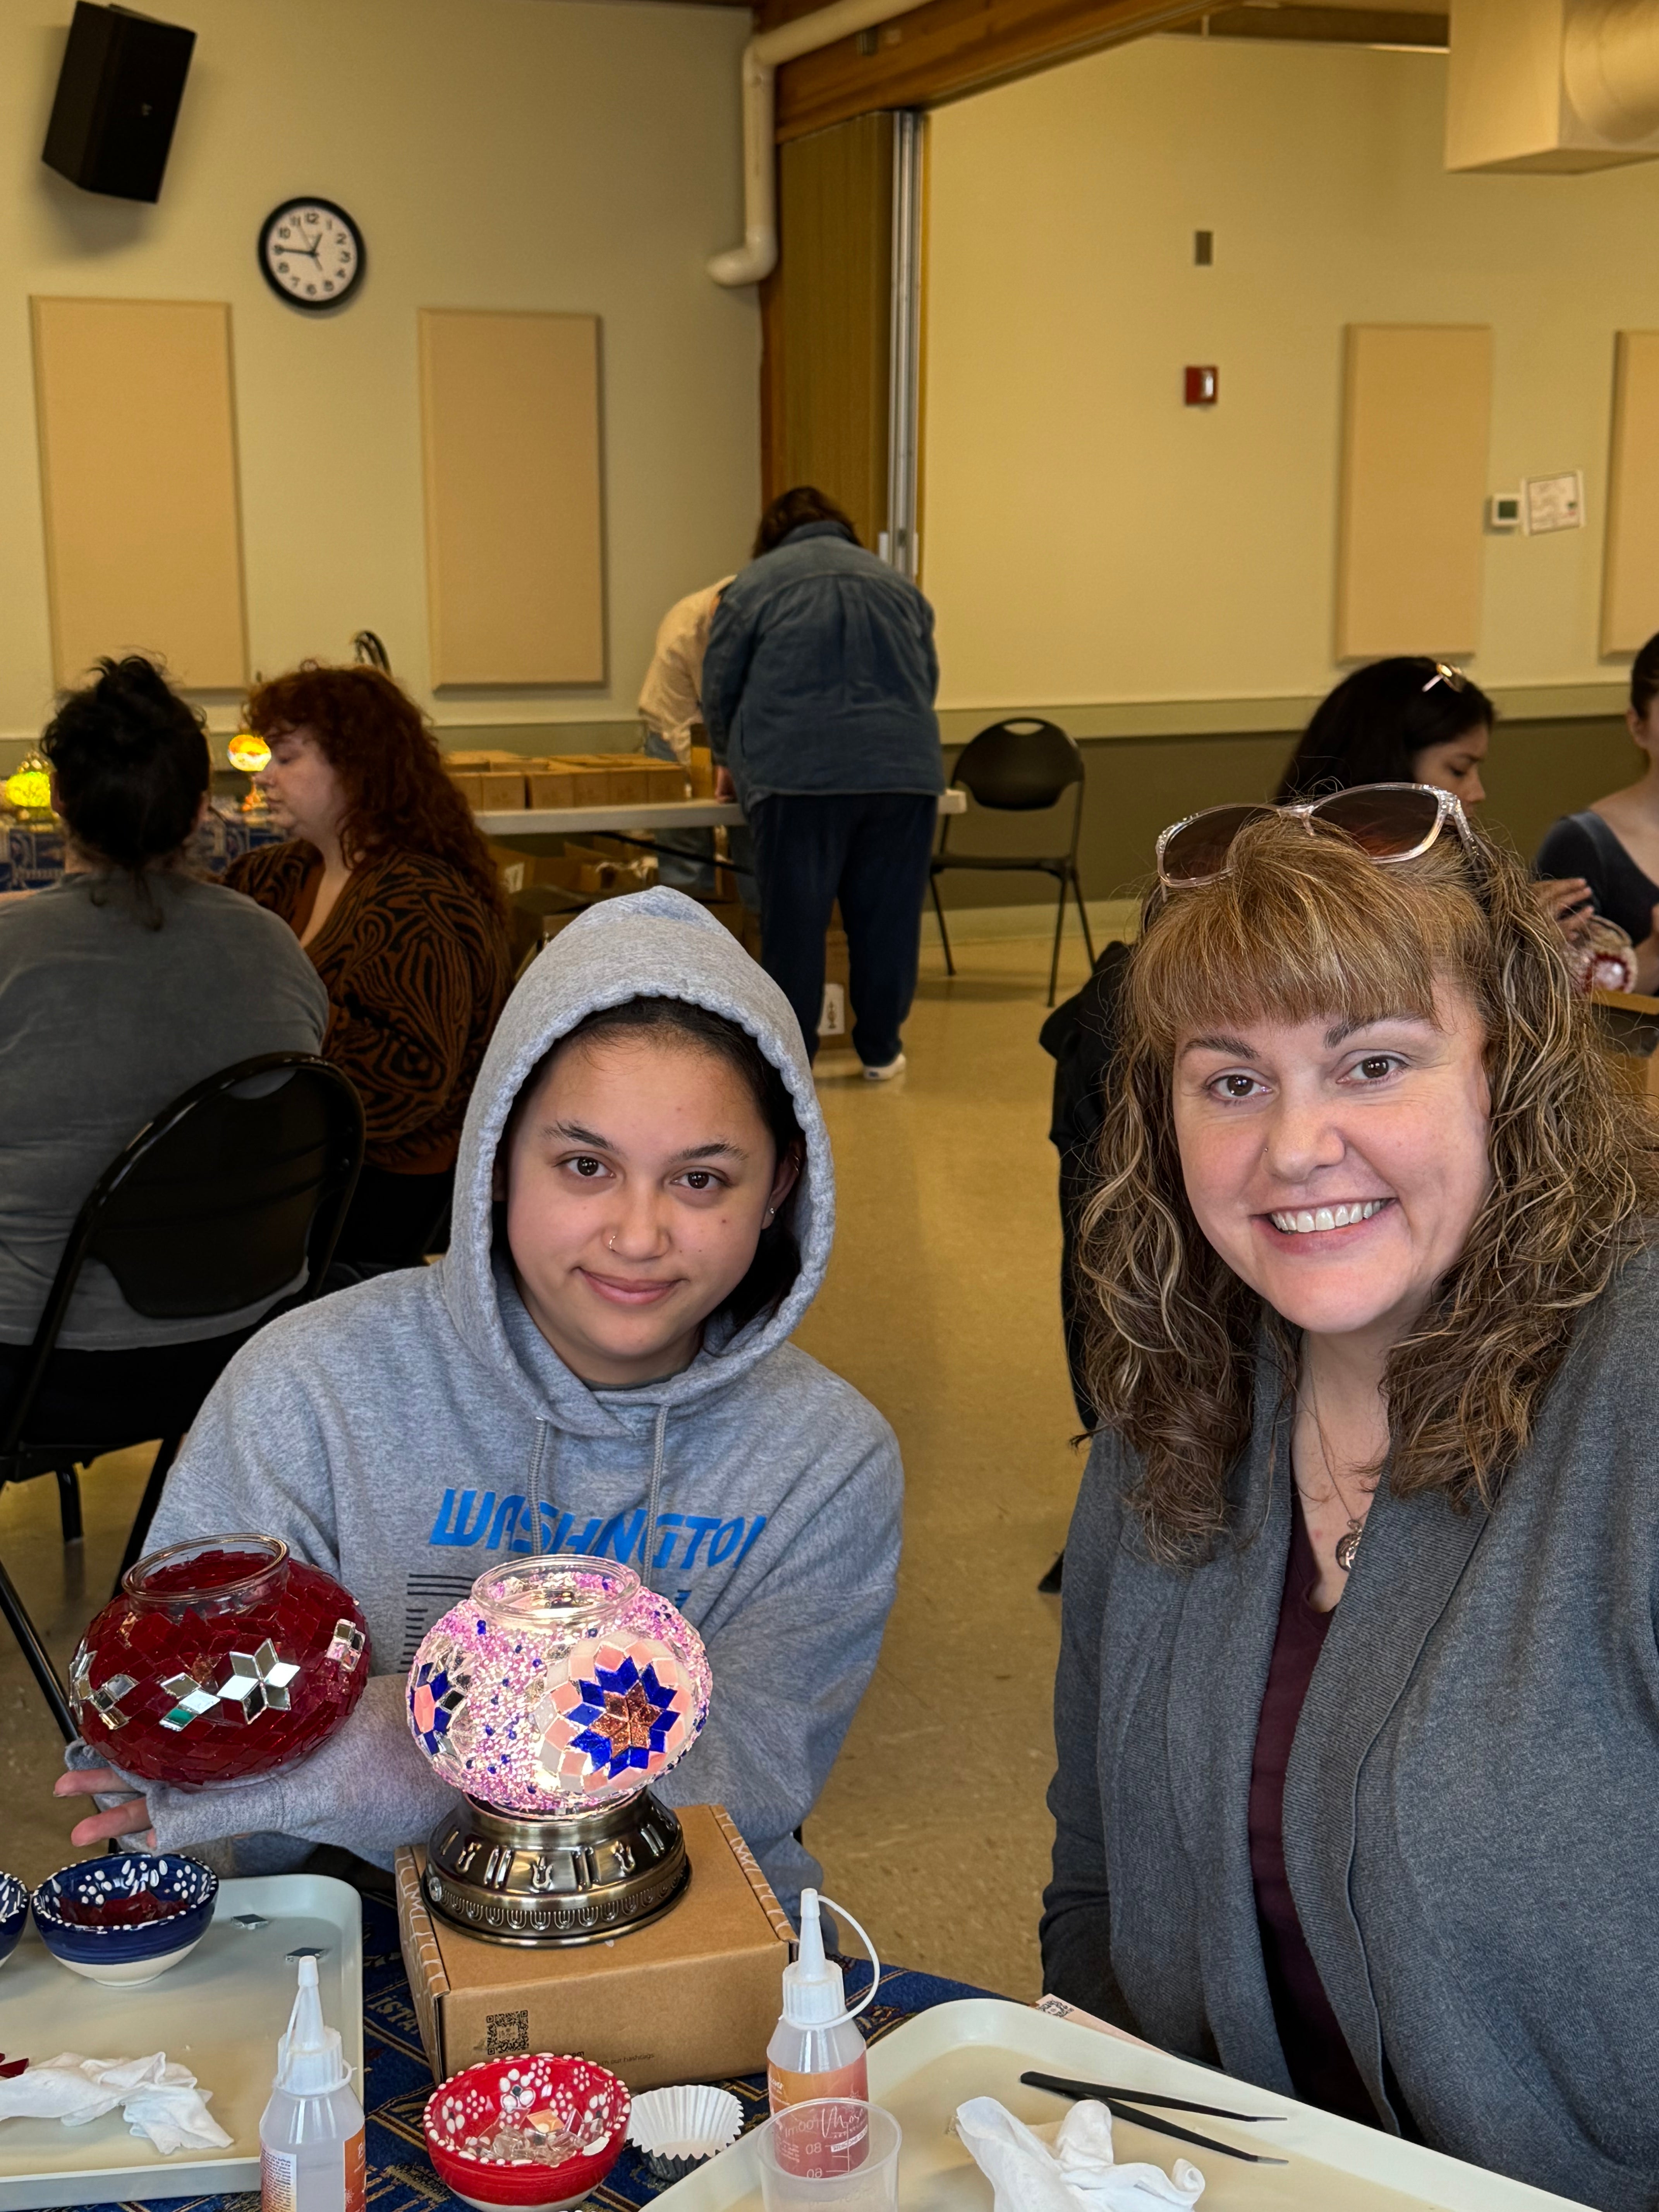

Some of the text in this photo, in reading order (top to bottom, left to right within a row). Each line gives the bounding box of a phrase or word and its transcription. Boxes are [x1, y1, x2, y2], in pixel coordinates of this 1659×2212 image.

[305, 213, 319, 224] 12
[326, 219, 332, 230] 1
[278, 227, 290, 239] 10
[336, 233, 347, 245] 2
[340, 252, 351, 263] 3
[623, 2053, 655, 2063] hashtags
